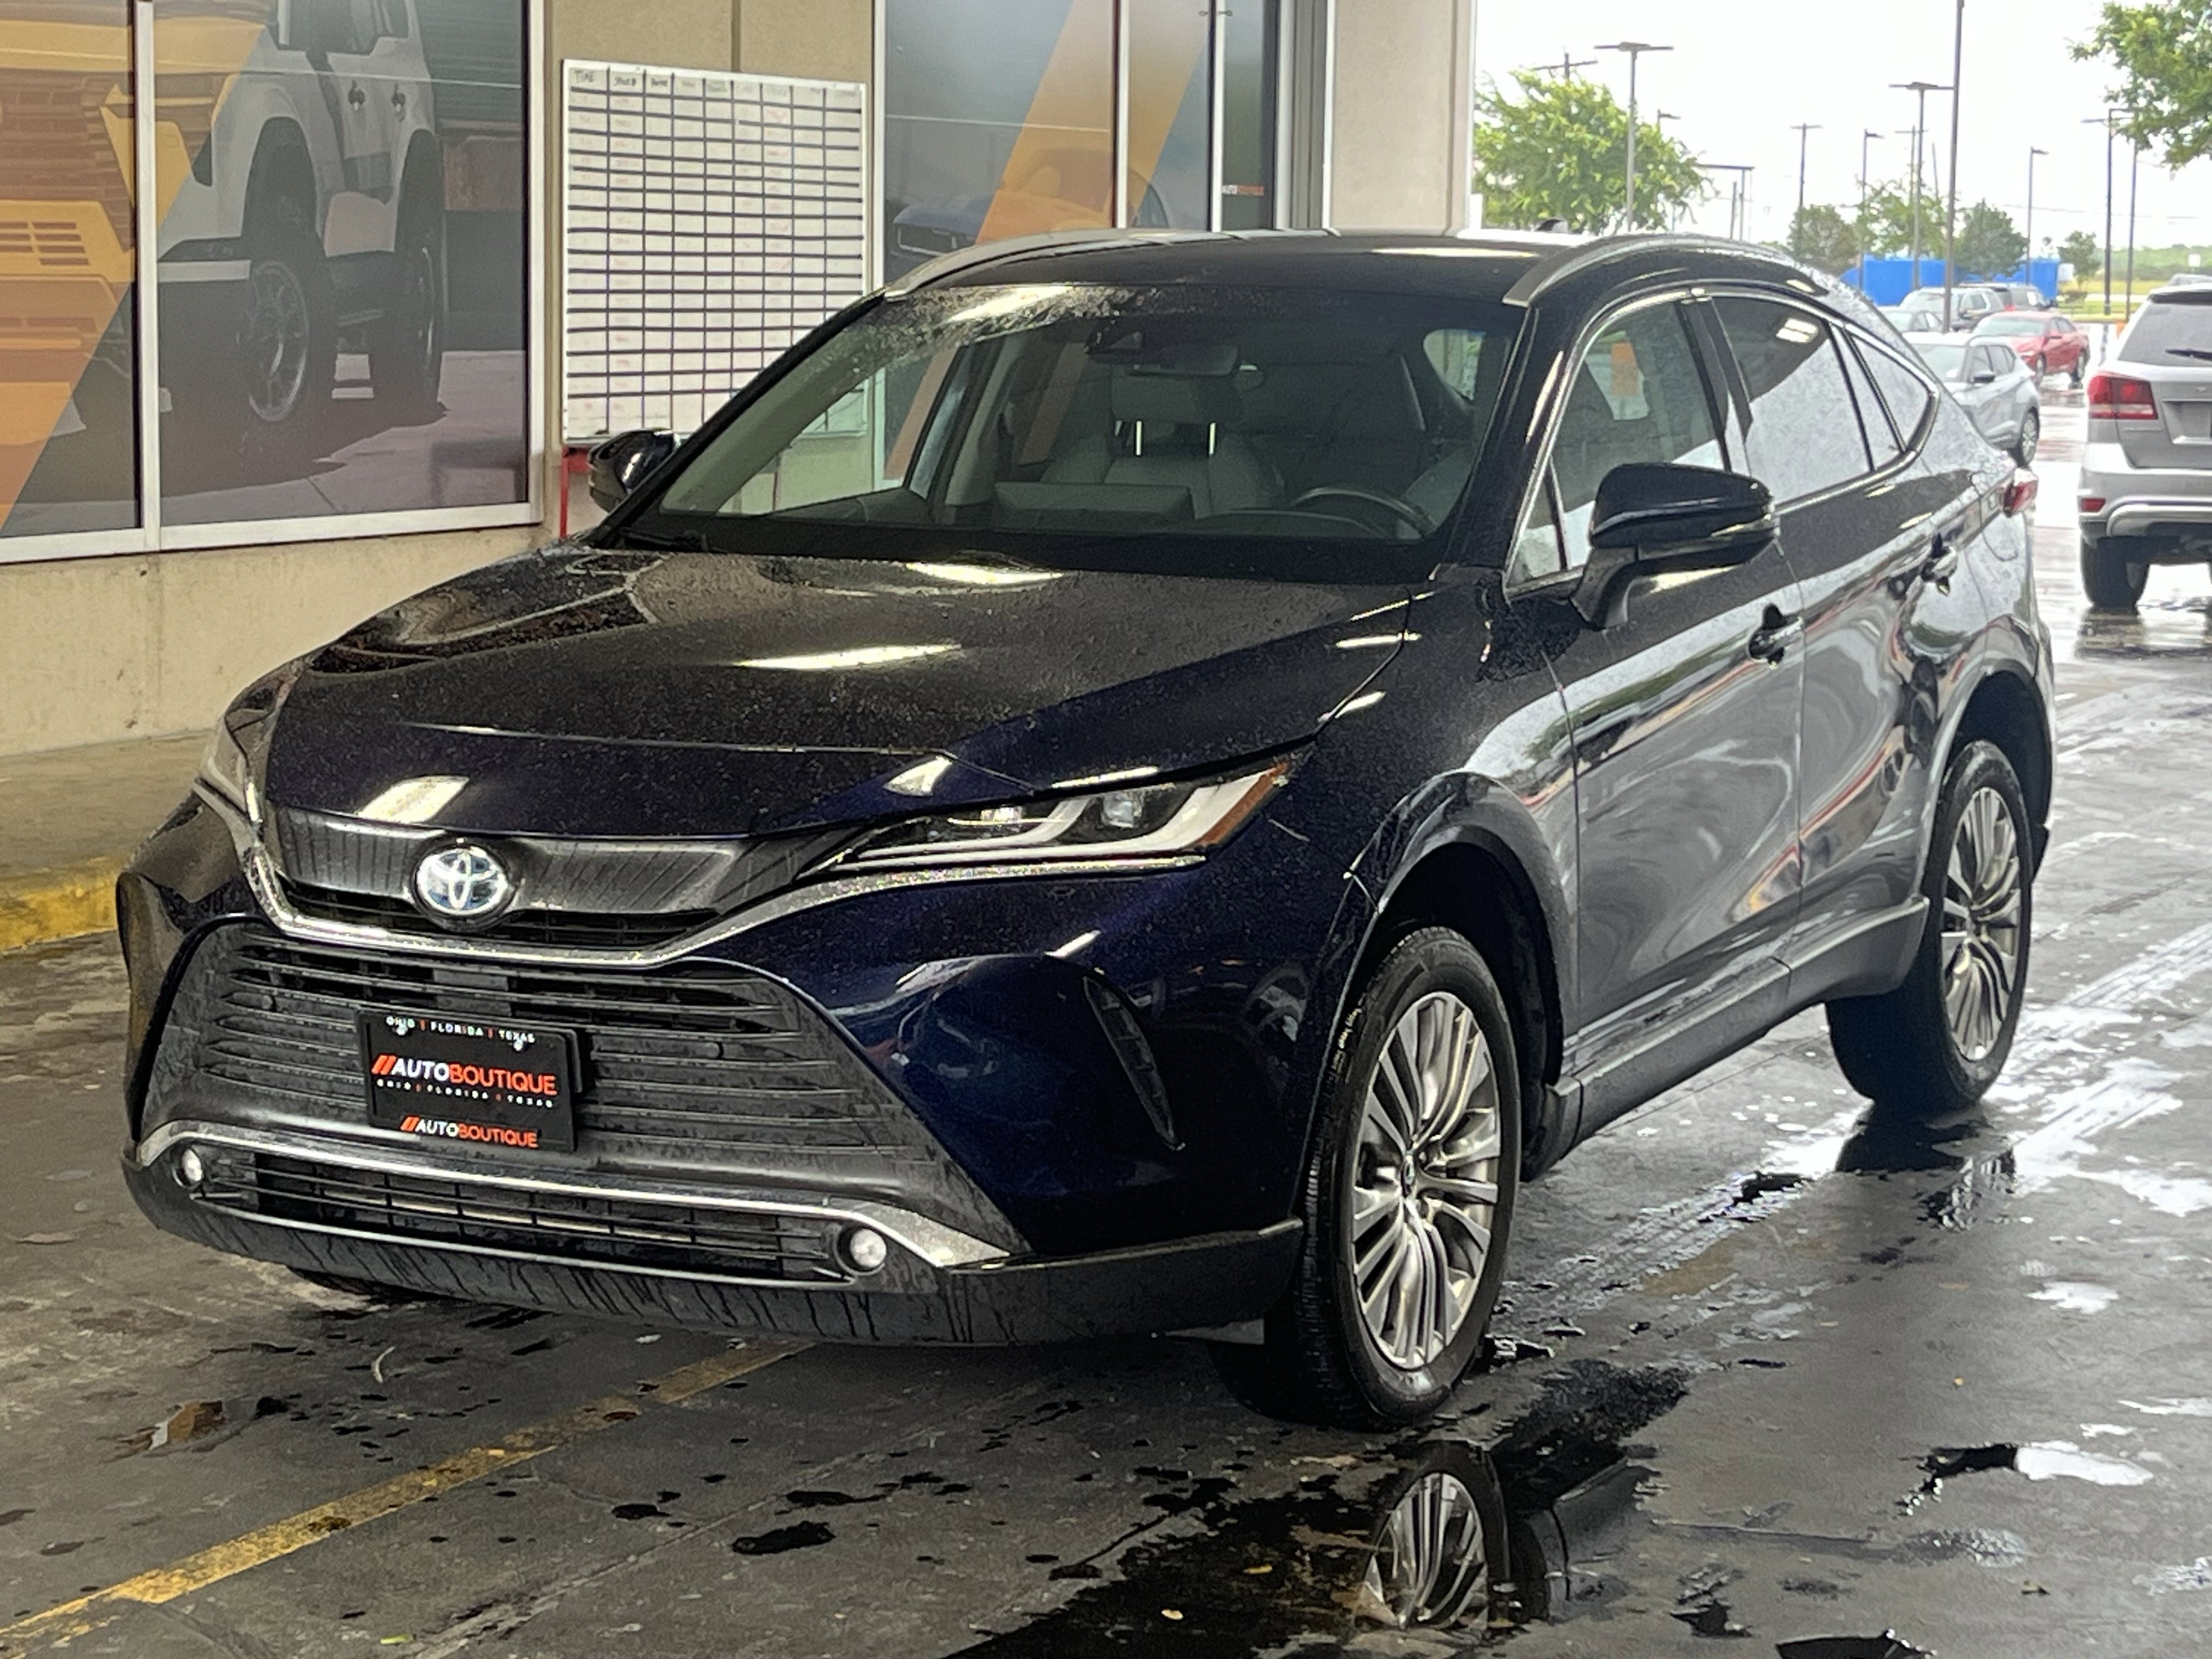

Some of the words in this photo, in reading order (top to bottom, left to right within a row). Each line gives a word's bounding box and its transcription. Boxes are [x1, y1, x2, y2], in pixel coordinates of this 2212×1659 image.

[431, 1021, 484, 1036] FLORIDA
[498, 1029, 535, 1043] TEXAS
[391, 1057, 558, 1096] AUTOBOUTIQUE
[415, 1118, 539, 1148] AUTOBOUTIQUE
